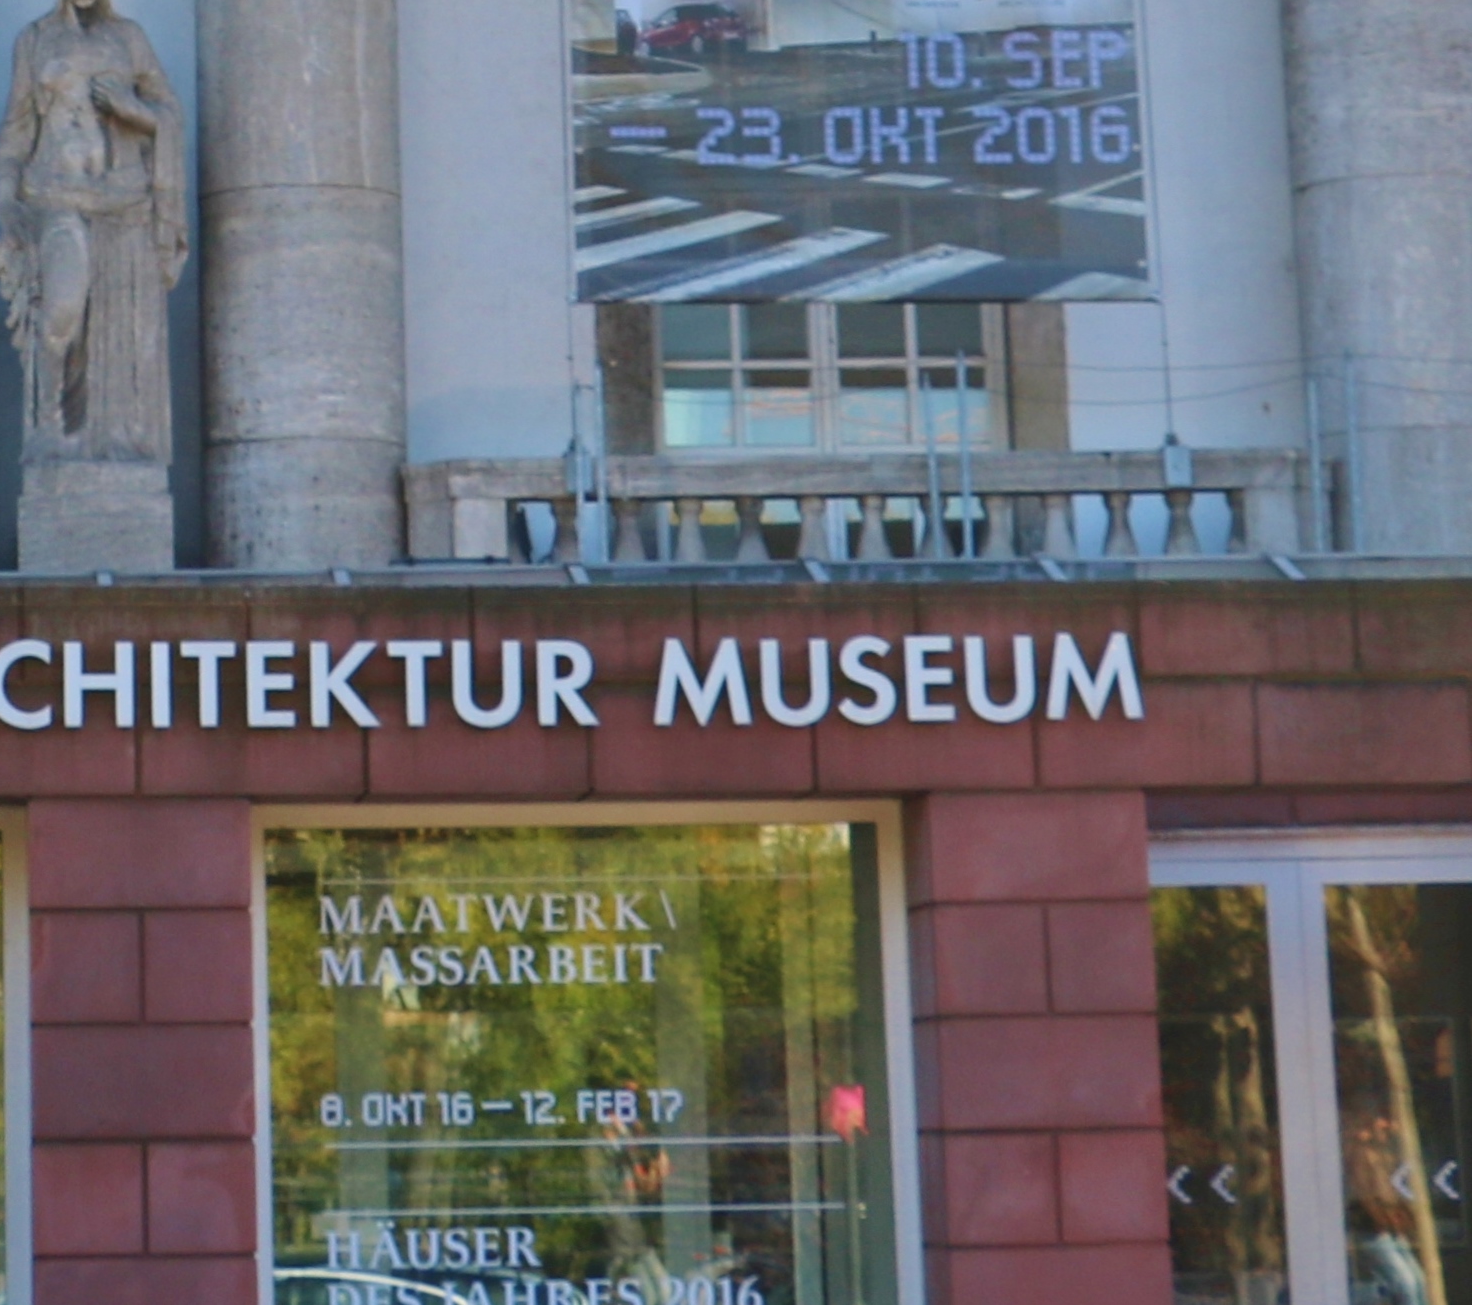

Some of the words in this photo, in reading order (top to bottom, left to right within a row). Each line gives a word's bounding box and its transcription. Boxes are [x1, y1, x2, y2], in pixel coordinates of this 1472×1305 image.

[898, 30, 982, 90] 10.
[1003, 29, 1129, 89] SEP
[695, 107, 800, 166] 23.
[823, 106, 945, 165] OKT
[972, 104, 1130, 164] 2016
[652, 631, 1145, 728] MUSEUM
[319, 942, 665, 987] MASSARBEIT
[320, 1093, 353, 1127] 8.
[361, 1093, 426, 1127] OKT
[436, 1093, 474, 1126] 16
[521, 1091, 566, 1125] 12.
[577, 1090, 638, 1124] FEB
[647, 1090, 684, 1123] 17
[325, 1221, 542, 1270] HÄUSER
